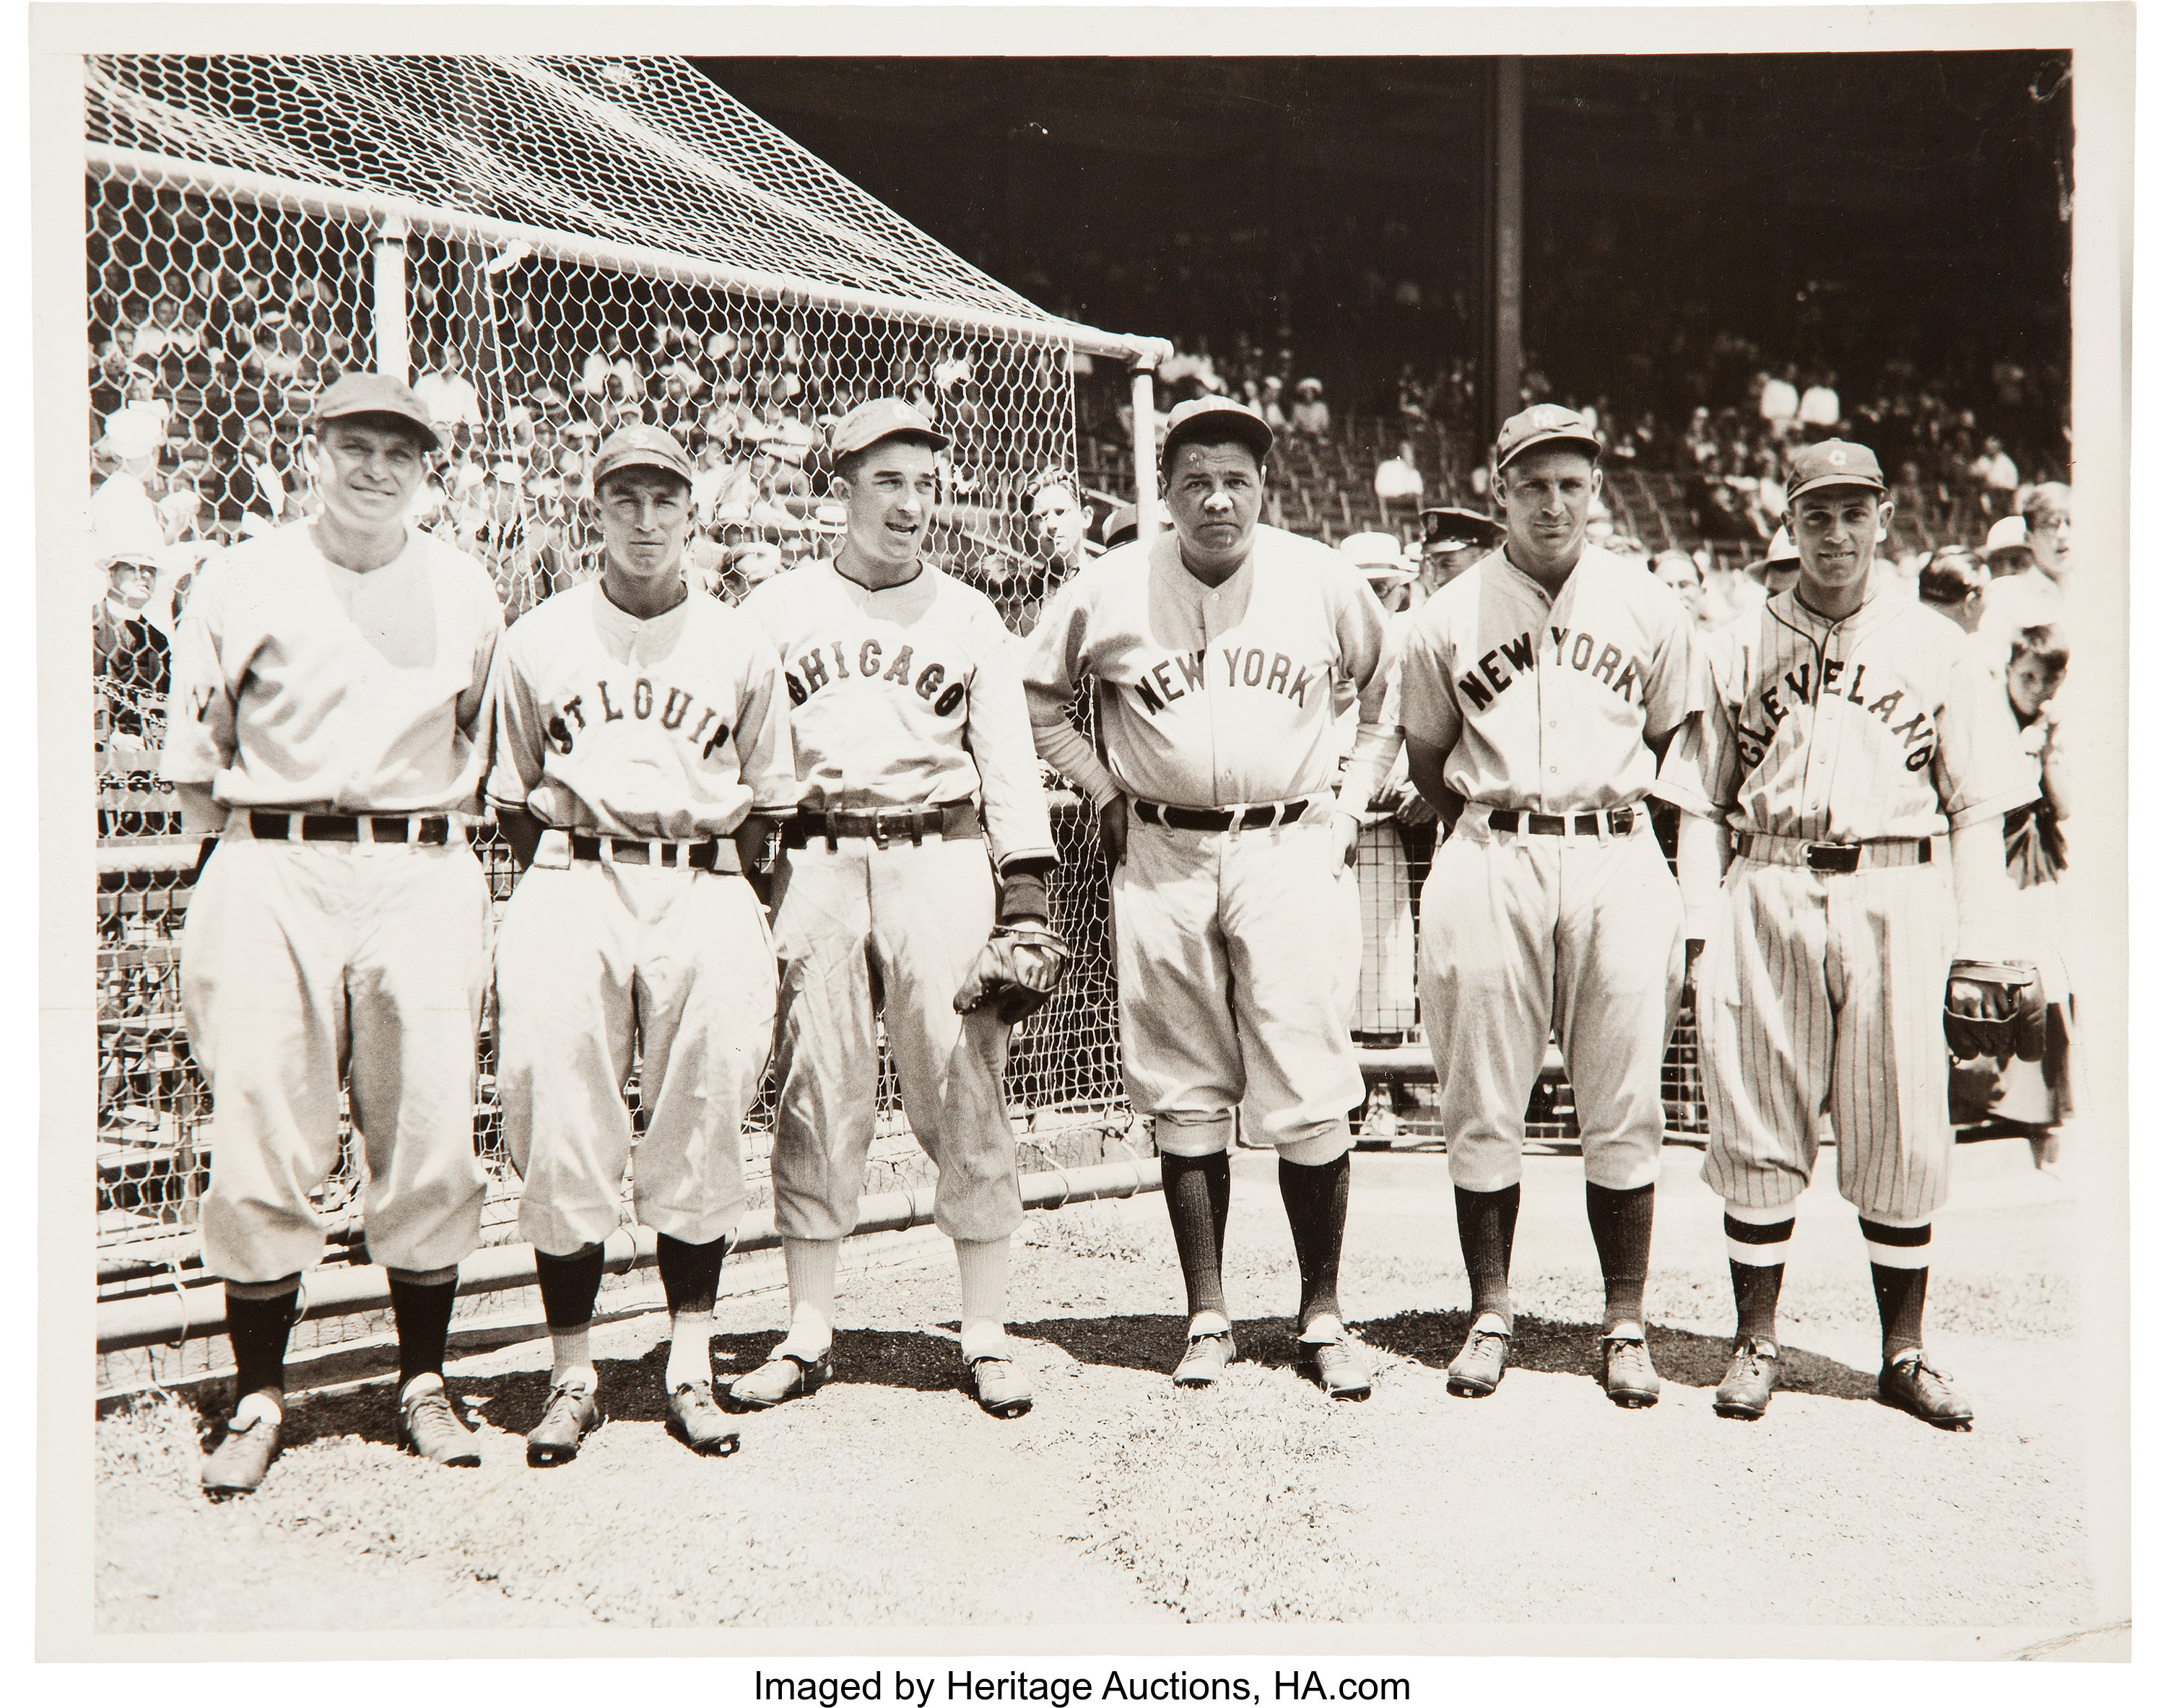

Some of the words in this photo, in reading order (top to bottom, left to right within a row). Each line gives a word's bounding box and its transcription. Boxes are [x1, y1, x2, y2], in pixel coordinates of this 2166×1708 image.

[1531, 409, 1557, 427] NY
[1828, 449, 1848, 466] C
[784, 639, 965, 717] CHICAGO
[1134, 649, 1206, 715] NEW
[1222, 647, 1316, 708] YORK
[1458, 632, 1534, 711] NEW
[1550, 626, 1639, 702] YORK
[549, 694, 586, 755] ST
[1738, 658, 1934, 772] CLEVELAND
